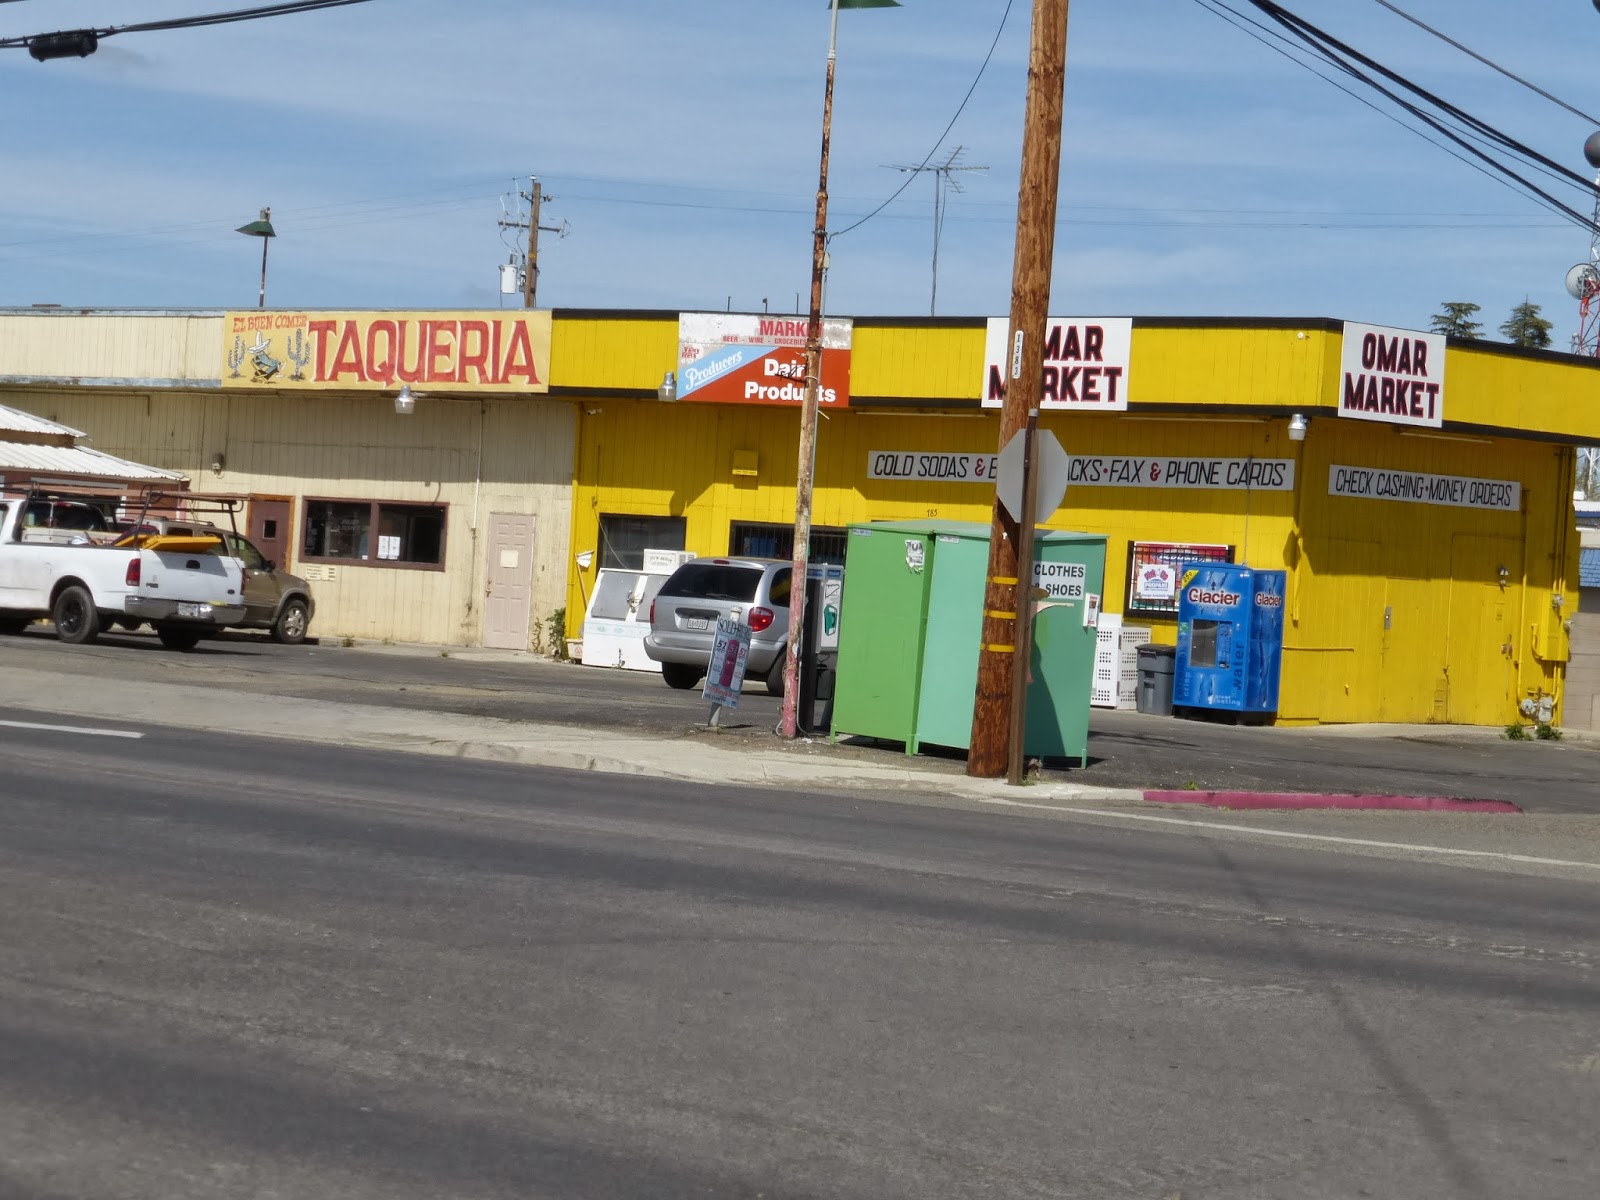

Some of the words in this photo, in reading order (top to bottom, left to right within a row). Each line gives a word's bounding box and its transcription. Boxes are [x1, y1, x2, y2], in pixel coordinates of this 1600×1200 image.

[233, 317, 246, 333] EL
[248, 314, 274, 331] BUEN
[275, 313, 308, 329] COMER
[760, 320, 823, 337] MARK
[722, 335, 738, 343] BEER
[749, 336, 764, 344] WINE
[1043, 325, 1104, 361] MAR
[307, 319, 542, 387] TAQUERIA
[1361, 332, 1428, 377] OMAR
[685, 351, 742, 390] Producers
[764, 358, 806, 378] Dair
[745, 381, 836, 402] Produts
[988, 365, 1123, 403] MRKET
[1343, 372, 1440, 419] MARKET
[874, 454, 915, 476] COLD
[918, 456, 969, 478] SODAS
[974, 458, 986, 477] &
[1150, 462, 1162, 482] &
[1165, 460, 1223, 484] PHONE
[1226, 462, 1286, 486] CARDS
[1335, 469, 1374, 495] CHECK
[1469, 481, 1512, 507] ORDERS
[1034, 564, 1084, 578] CLOTHES
[1045, 583, 1082, 597] SHOES
[1188, 588, 1240, 606] Glacier
[1255, 593, 1281, 606] Glacier
[717, 618, 737, 635] SOLD
[1232, 643, 1245, 690] water
